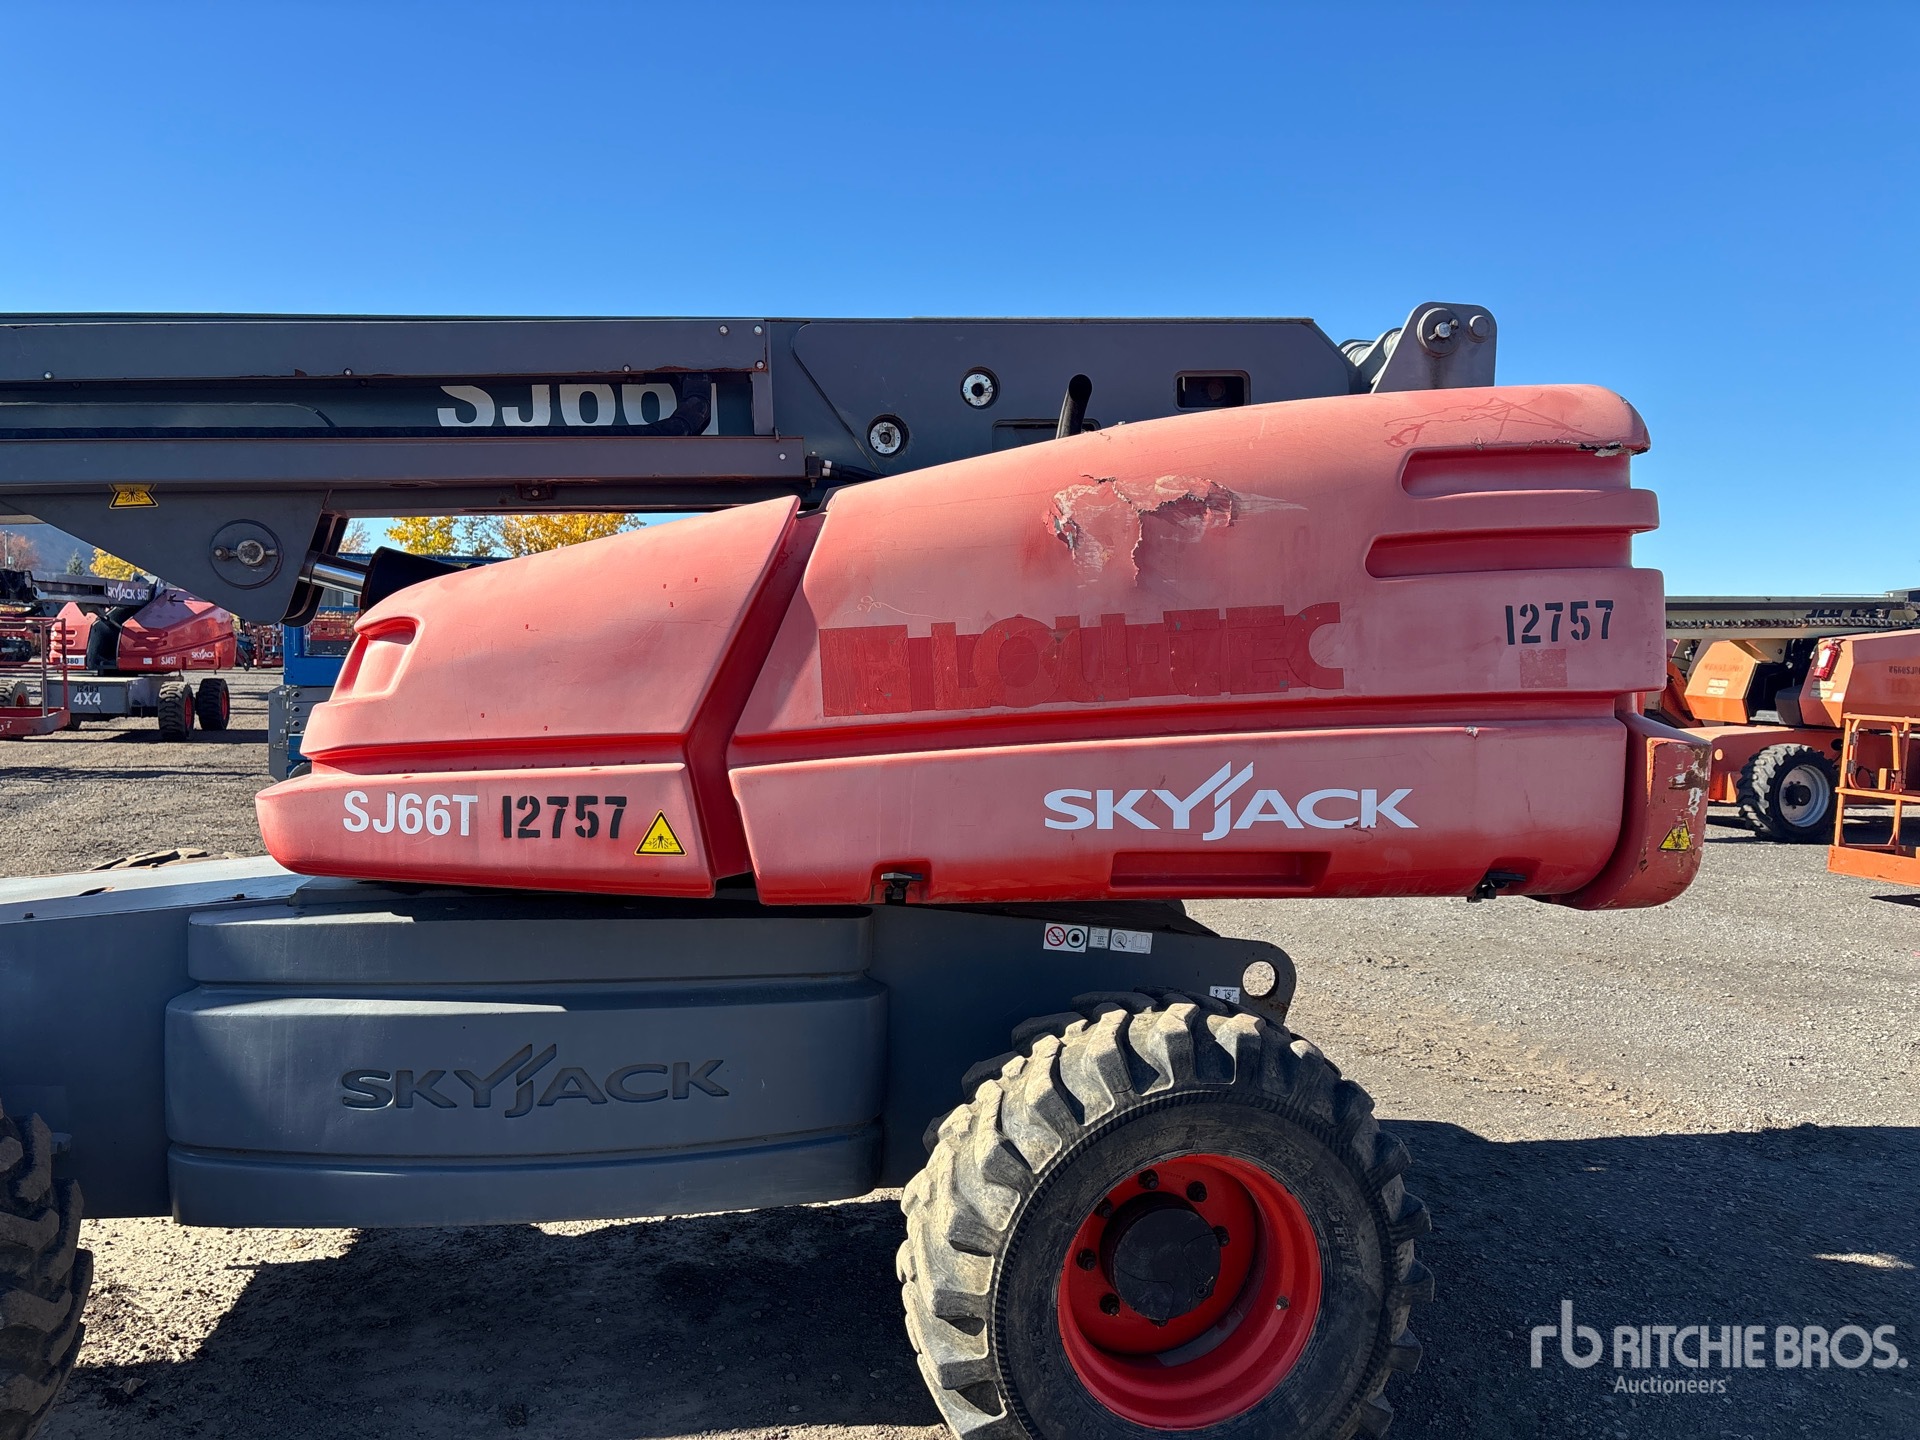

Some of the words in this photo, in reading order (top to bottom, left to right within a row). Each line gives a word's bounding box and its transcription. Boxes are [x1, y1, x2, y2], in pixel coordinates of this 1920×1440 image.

[1505, 600, 1614, 645] 12757
[161, 656, 177, 665] SJ45T
[191, 648, 215, 659] SKYJACK
[73, 692, 102, 705] 4X4
[343, 790, 479, 837] SJ66T
[502, 795, 628, 839] 12757
[1043, 761, 1420, 841] SKYJACK
[341, 1043, 730, 1118] SKYJACK
